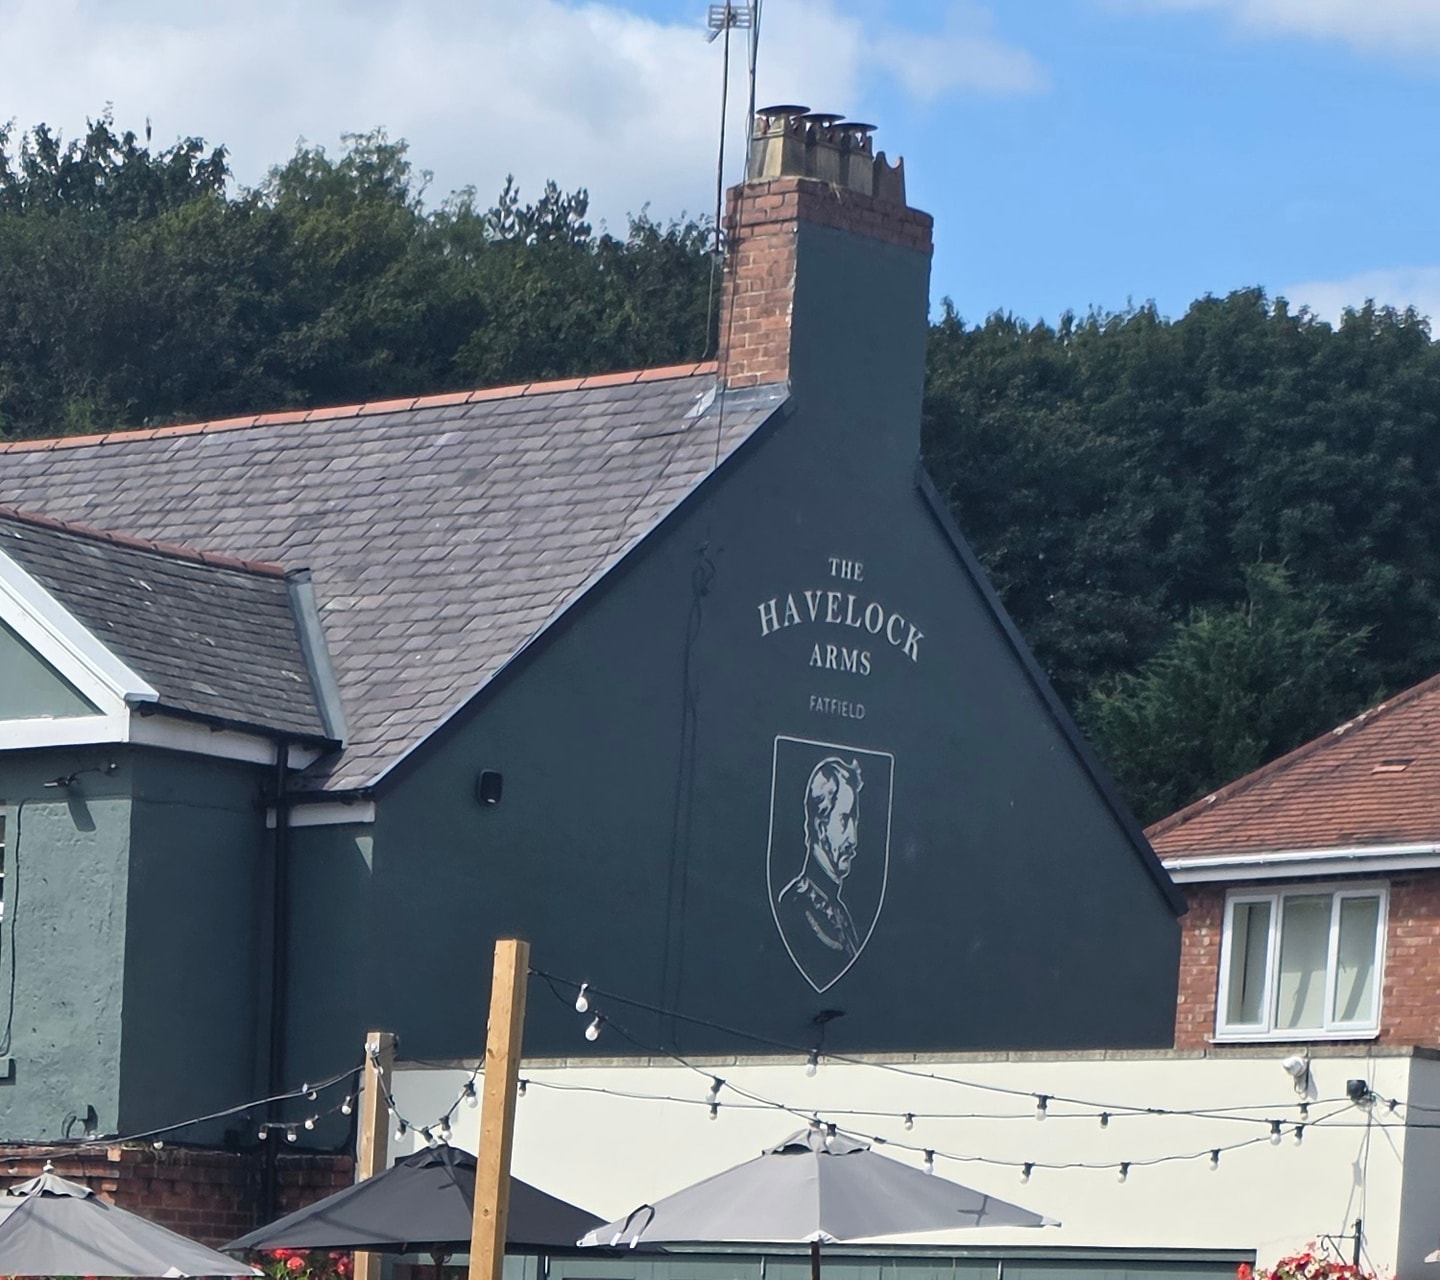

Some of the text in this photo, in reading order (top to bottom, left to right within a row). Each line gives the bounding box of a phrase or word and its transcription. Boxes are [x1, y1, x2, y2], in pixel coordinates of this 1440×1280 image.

[828, 557, 864, 582] THE
[757, 590, 925, 663] HAVELOCK
[809, 643, 871, 676] ARMS
[810, 695, 866, 720] FATFIELD
